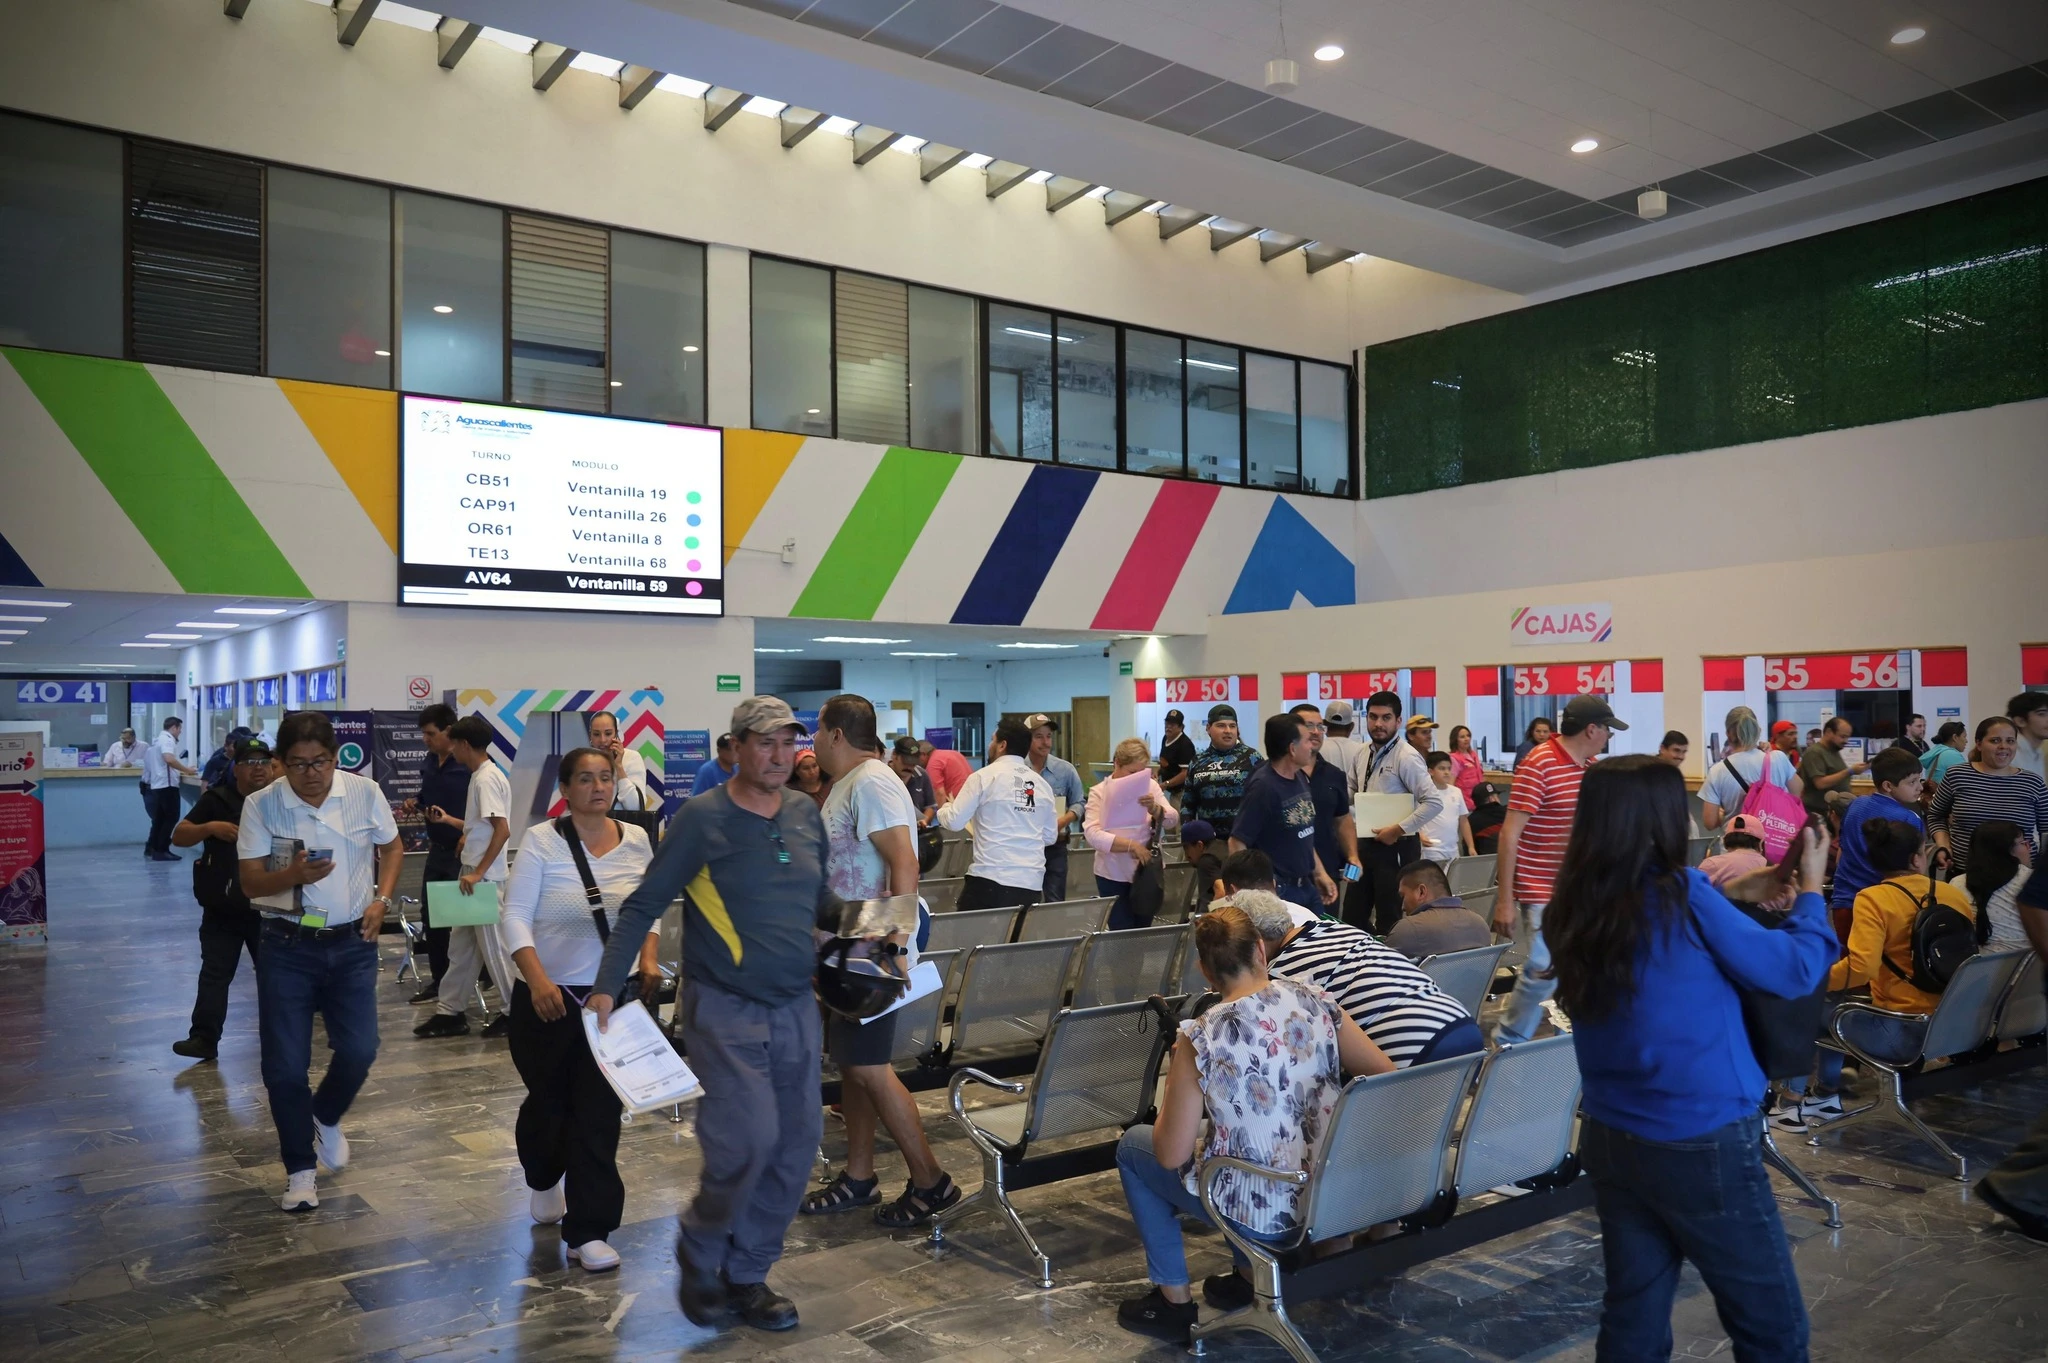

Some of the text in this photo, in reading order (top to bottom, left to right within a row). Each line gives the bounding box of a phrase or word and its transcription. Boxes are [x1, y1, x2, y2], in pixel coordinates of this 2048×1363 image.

[456, 415, 533, 430] Aguascalientes
[471, 450, 619, 471] TURNO MODULO
[466, 473, 667, 500] CB51 Ventanilla 19
[460, 497, 667, 523] CAP91 Ventanilla 26
[468, 522, 662, 546] OR61 Ventanilla 8
[468, 547, 667, 569] TE13 Ventanilla 68
[465, 571, 668, 593] AV64 Ventanilla 59
[1524, 612, 1597, 635] CAJAS
[1514, 665, 1613, 695] 53 54
[1765, 654, 1898, 690] 55 56
[18, 681, 107, 703] 40 41
[256, 679, 279, 706] 45 46
[309, 669, 336, 702] 47 48
[1167, 679, 1228, 702] 49 50
[1320, 673, 1397, 699] 51 52
[0, 761, 22, 772] rio
